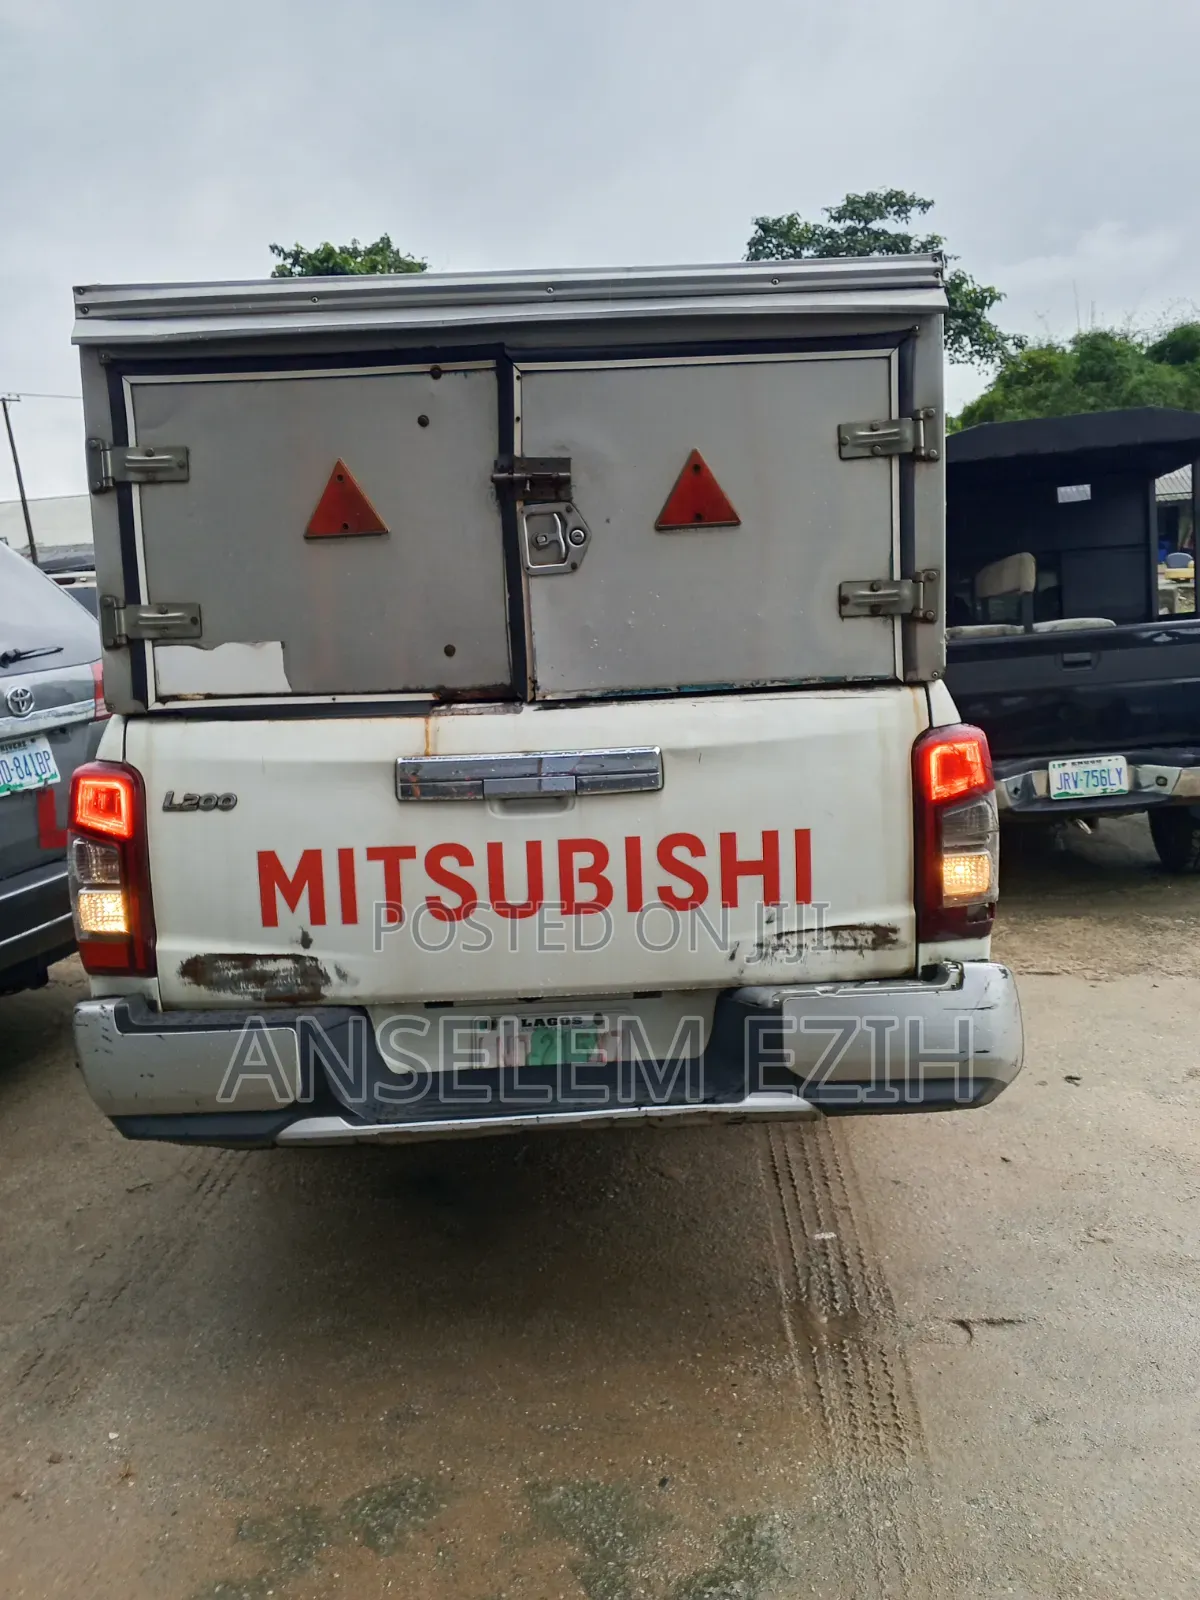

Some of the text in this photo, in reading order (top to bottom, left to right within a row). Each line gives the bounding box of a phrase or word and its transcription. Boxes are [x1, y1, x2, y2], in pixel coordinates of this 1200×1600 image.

[0, 750, 51, 785] D-841BP
[1056, 767, 1123, 791] JRV-756LY
[162, 790, 238, 812] L200
[257, 828, 813, 928] MITSUBISHI
[520, 1016, 583, 1028] LAGOS
